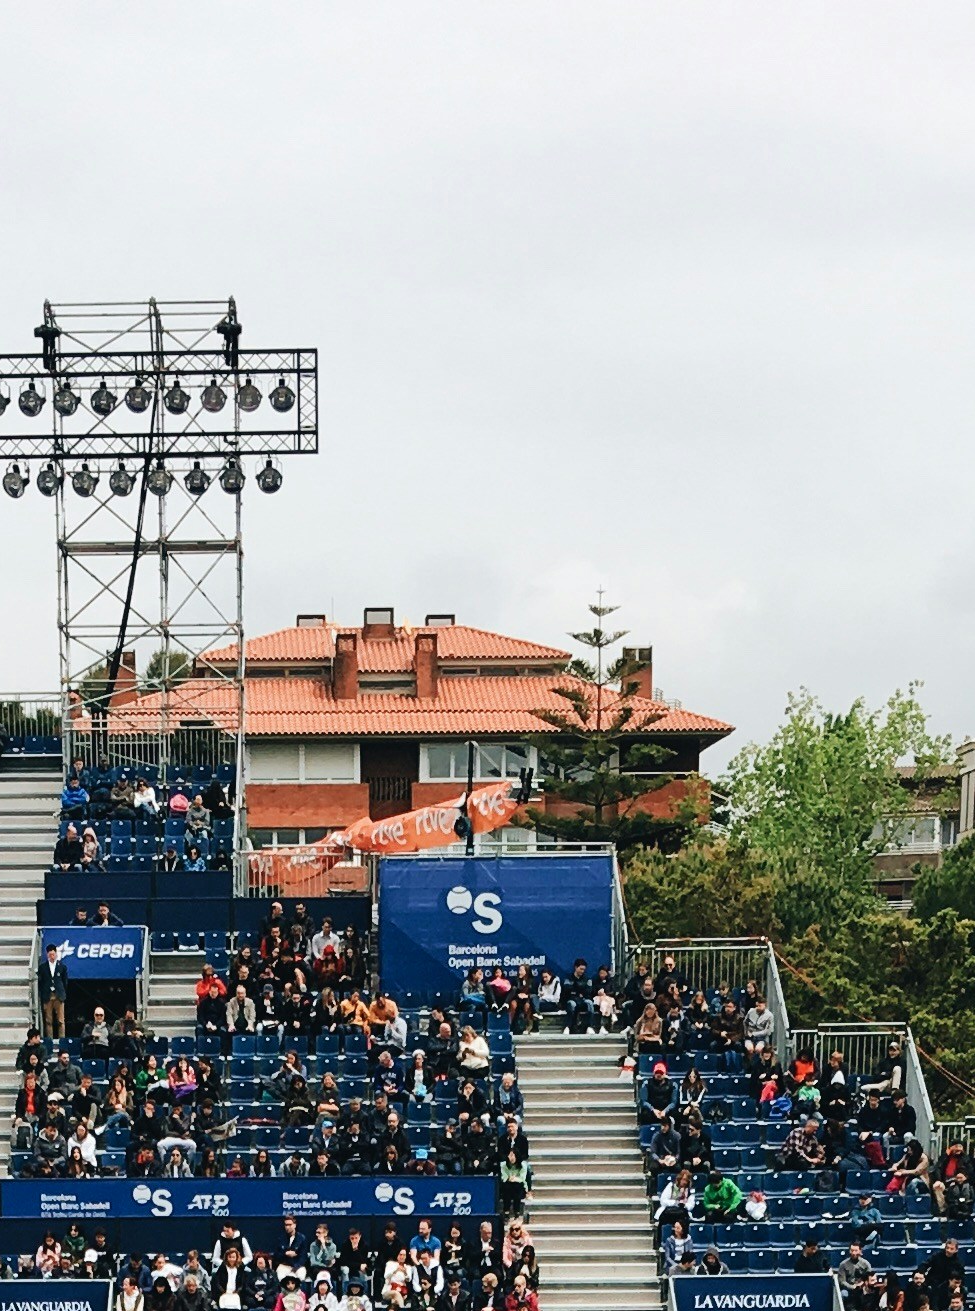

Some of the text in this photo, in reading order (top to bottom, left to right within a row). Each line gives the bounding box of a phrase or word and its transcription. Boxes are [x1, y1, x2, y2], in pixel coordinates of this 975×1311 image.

[415, 808, 453, 836] rtve
[371, 821, 407, 846] rtve
[77, 943, 135, 959] CEPSA
[448, 944, 498, 955] Barcelona
[448, 955, 546, 969] Open Banc Sabadell
[187, 1194, 230, 1210] ATP
[429, 1192, 472, 1208] ATP
[694, 1293, 811, 1309] LA VANGUARDIA
